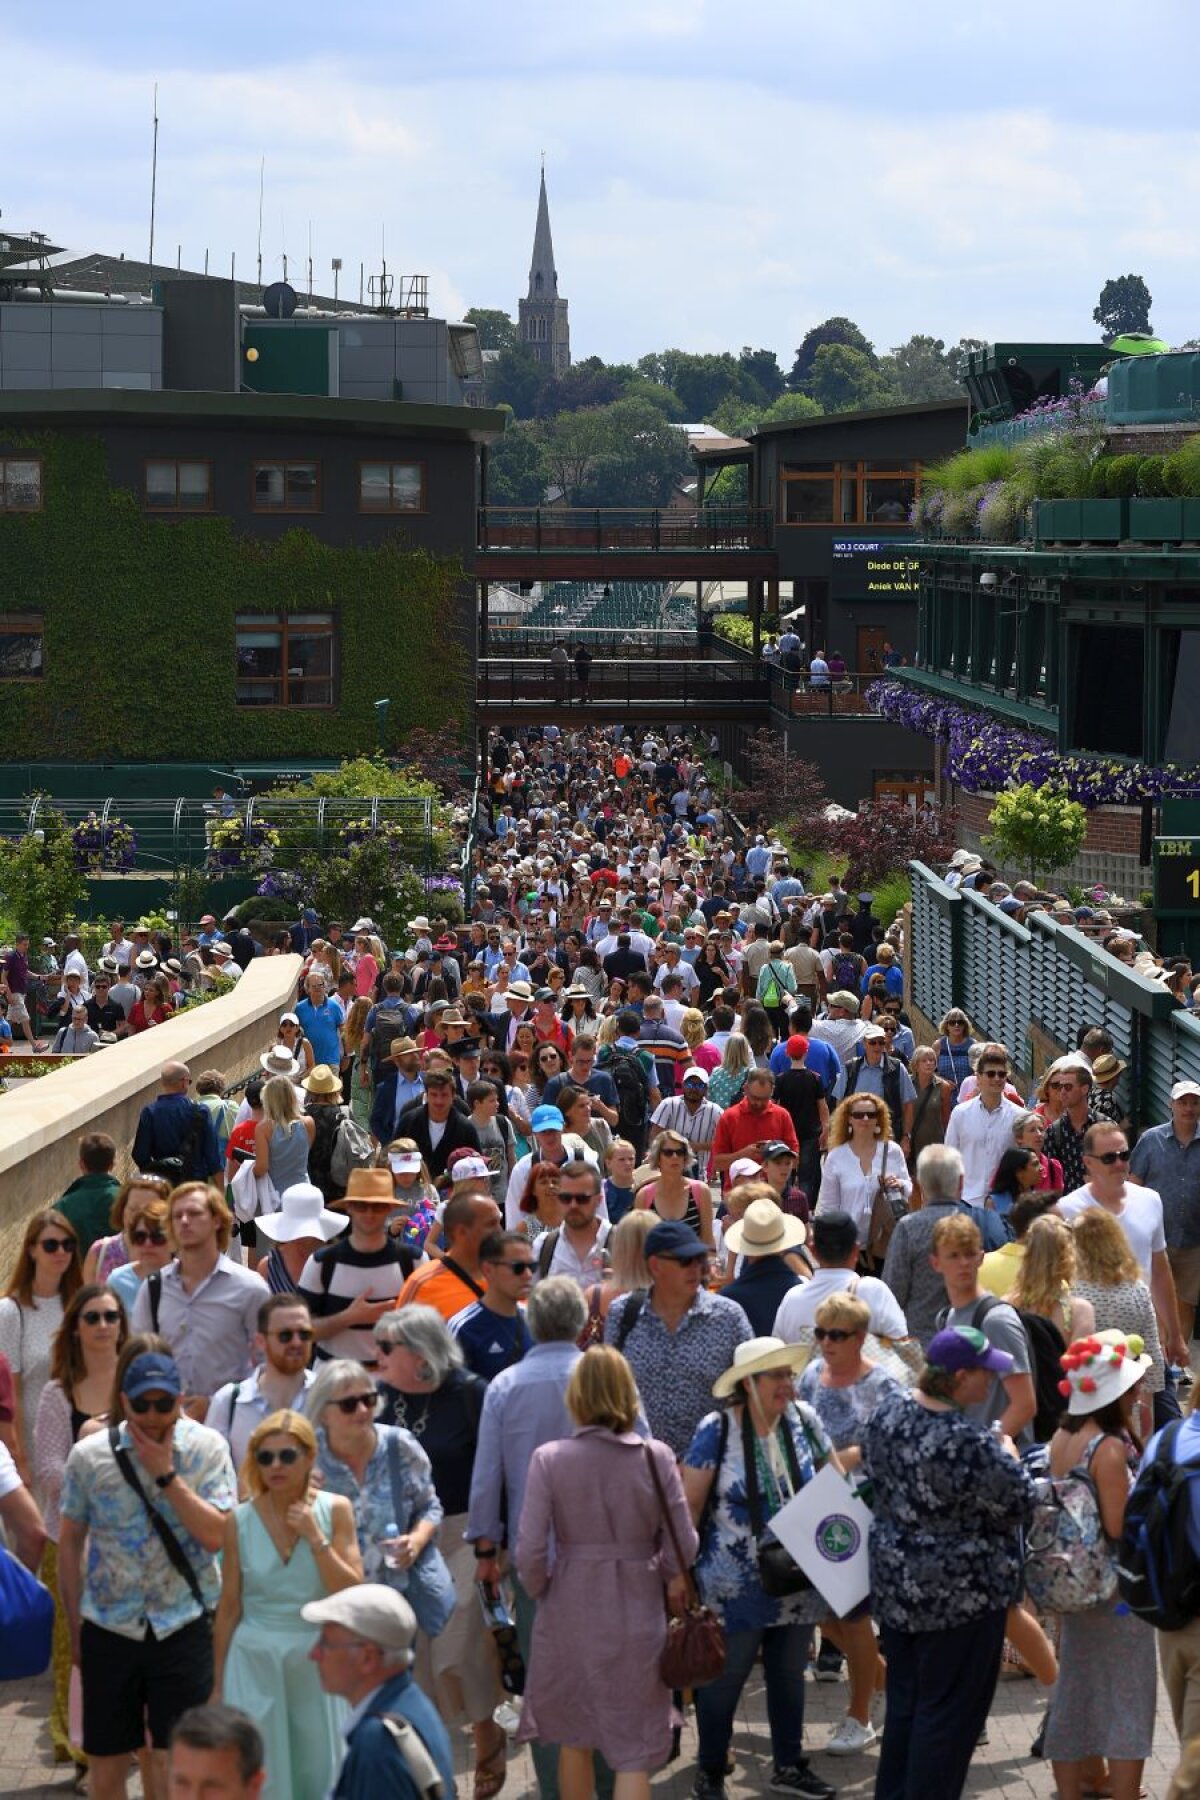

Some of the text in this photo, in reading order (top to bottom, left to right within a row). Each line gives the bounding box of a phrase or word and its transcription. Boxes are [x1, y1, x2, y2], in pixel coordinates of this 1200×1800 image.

[867, 562, 892, 570] Diede
[893, 562, 905, 570] DE
[867, 582, 892, 590] Aniek
[893, 582, 912, 590] VAN
[1159, 841, 1192, 856] IBM
[1186, 869, 1200, 898] 1
